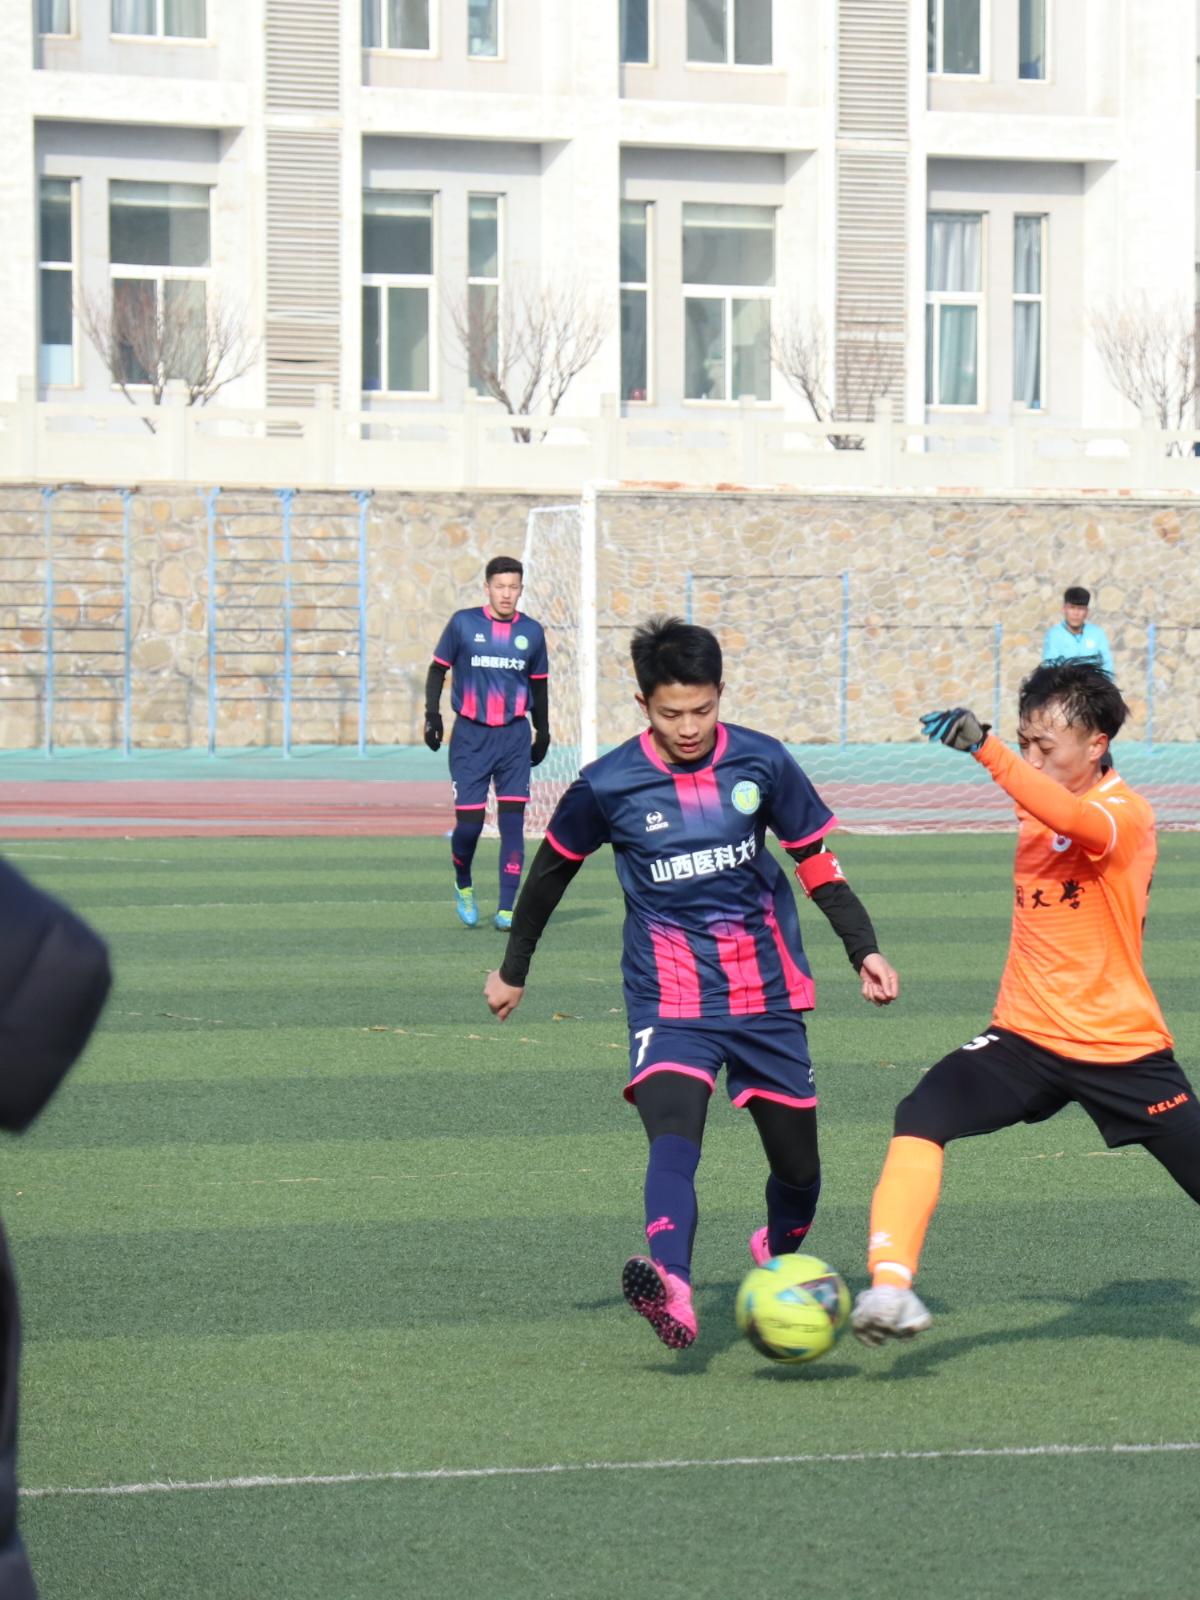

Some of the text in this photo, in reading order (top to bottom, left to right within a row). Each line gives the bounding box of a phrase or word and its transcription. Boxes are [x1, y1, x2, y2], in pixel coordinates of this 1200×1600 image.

[471, 655, 526, 671] 山西医科大学
[635, 1026, 654, 1068] 7
